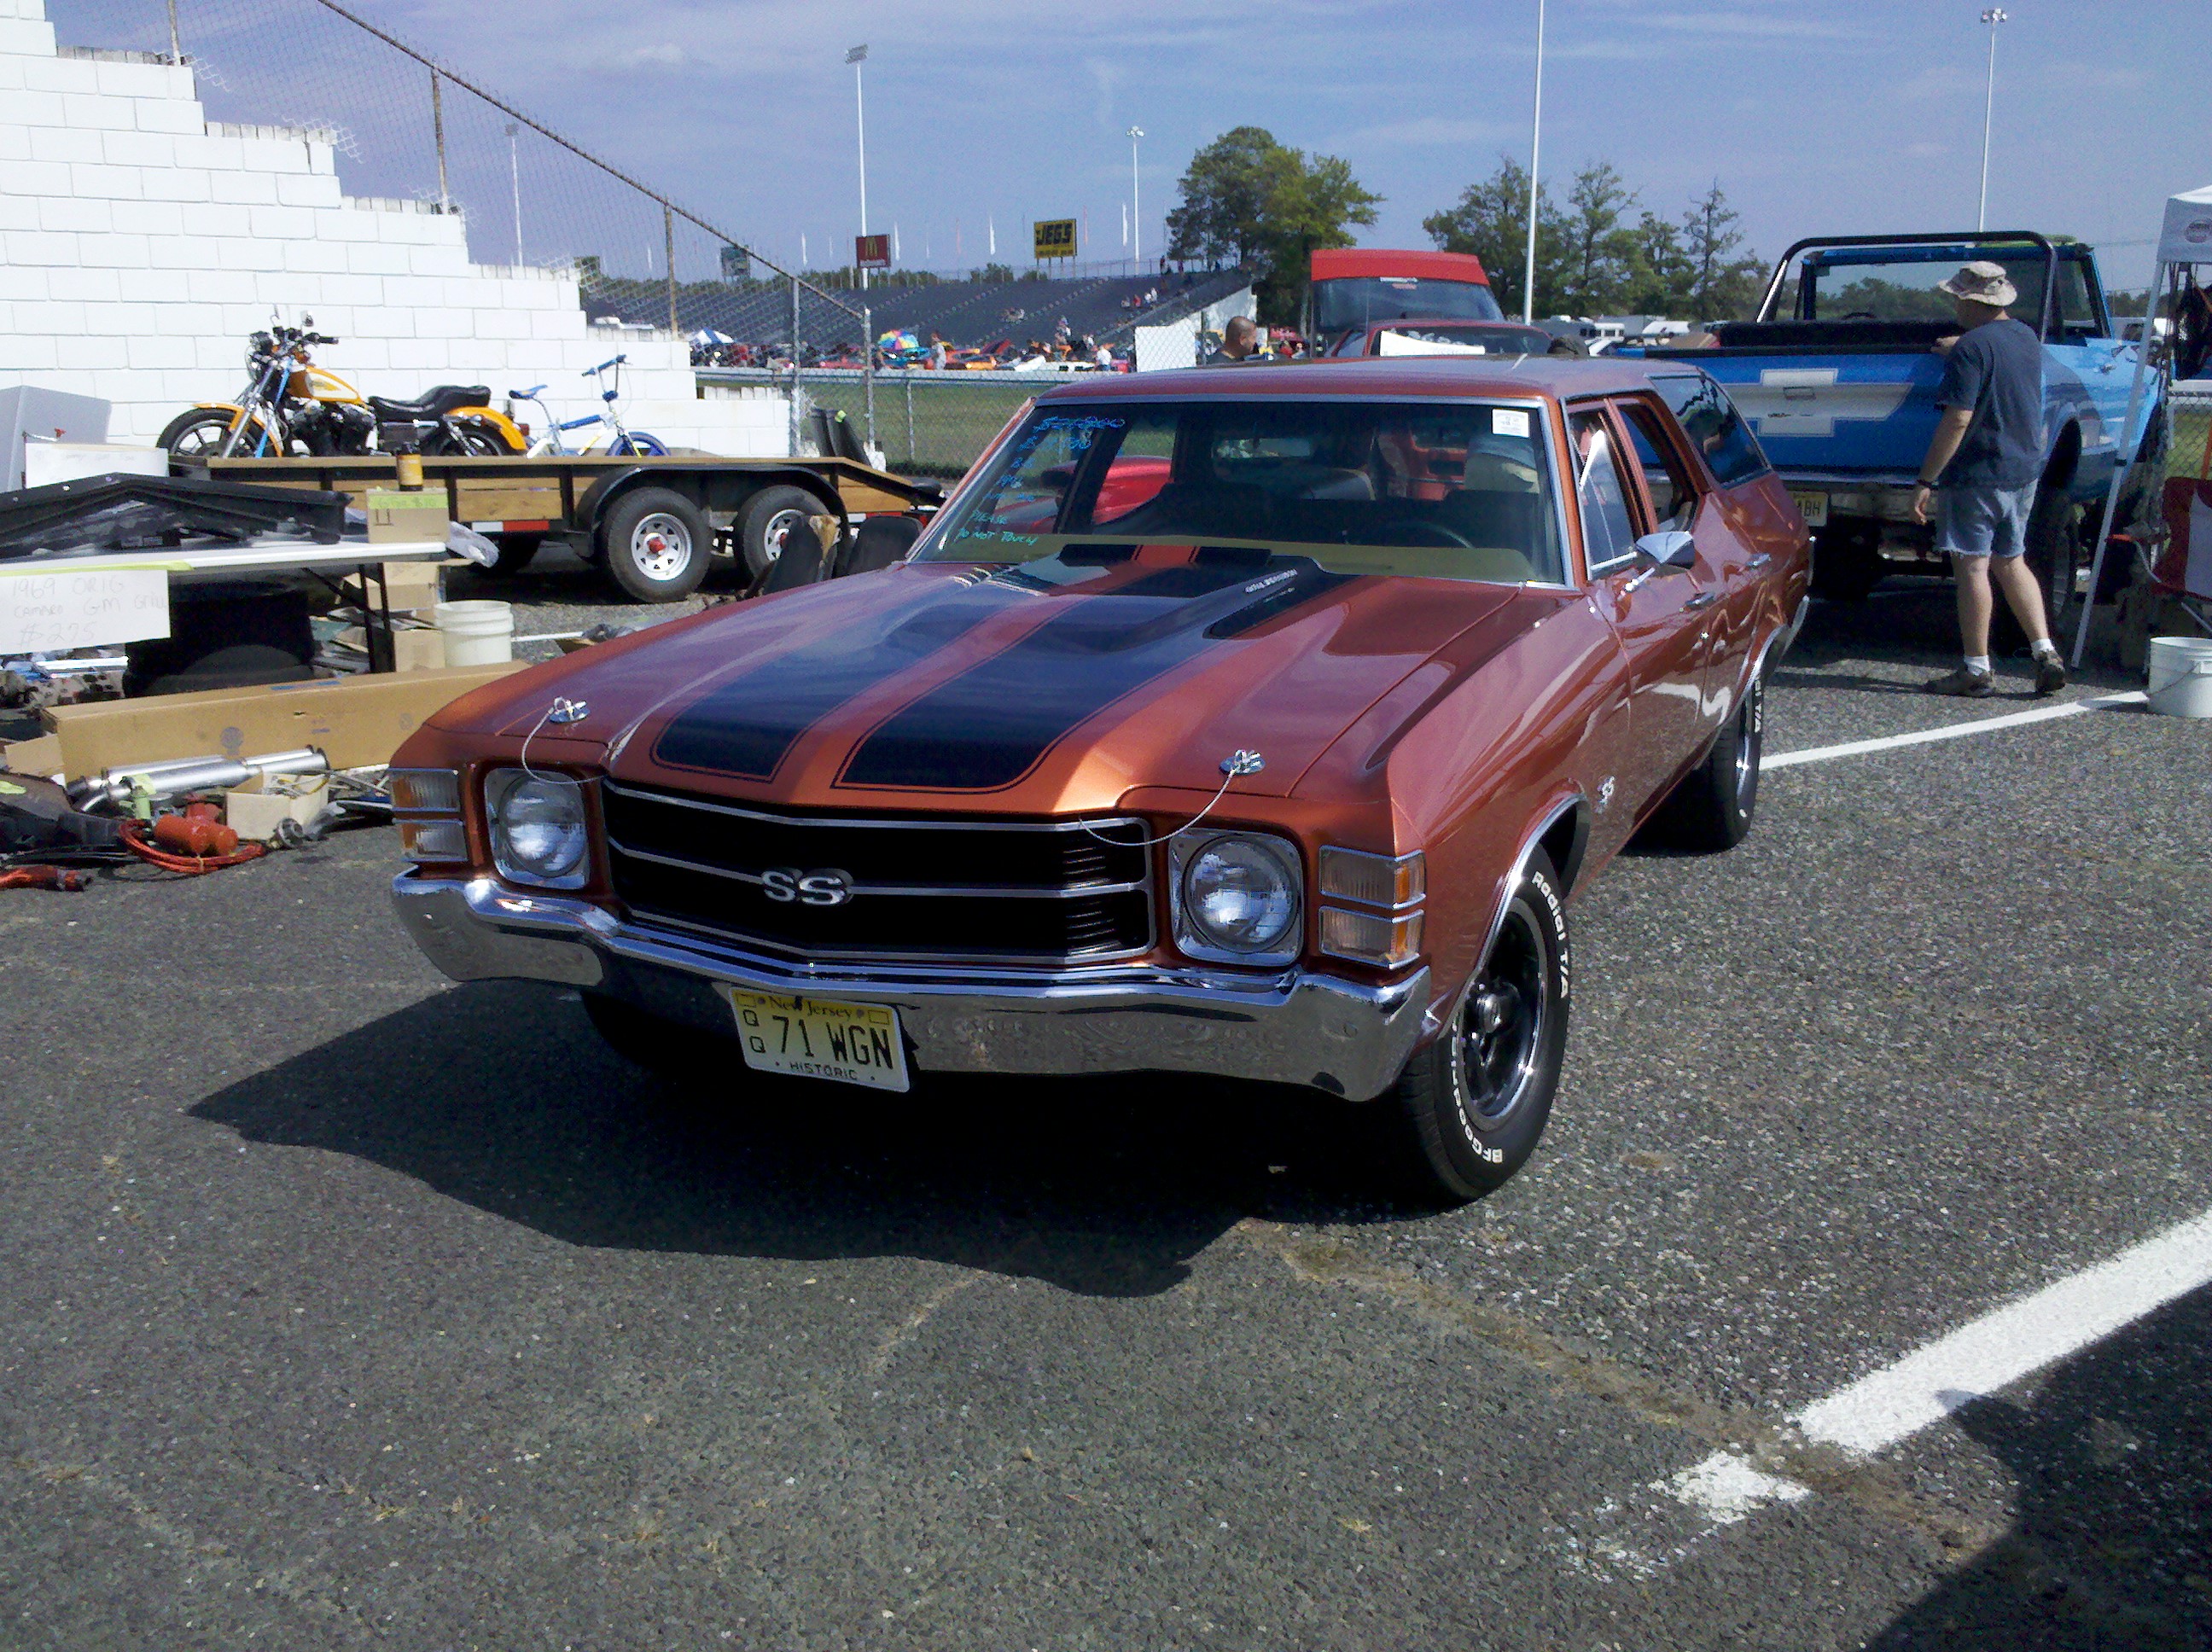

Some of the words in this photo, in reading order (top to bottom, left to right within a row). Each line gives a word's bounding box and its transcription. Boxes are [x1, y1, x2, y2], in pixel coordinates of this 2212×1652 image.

[1036, 224, 1073, 245] JEGS
[12, 578, 55, 599] 1969
[72, 575, 125, 596] ORIG
[83, 597, 121, 616] GM
[761, 869, 853, 905] SS
[807, 1000, 853, 1021] Jersey
[772, 1014, 815, 1058] 71
[826, 1021, 894, 1070] WGN
[789, 1061, 859, 1081] HISTORIC
